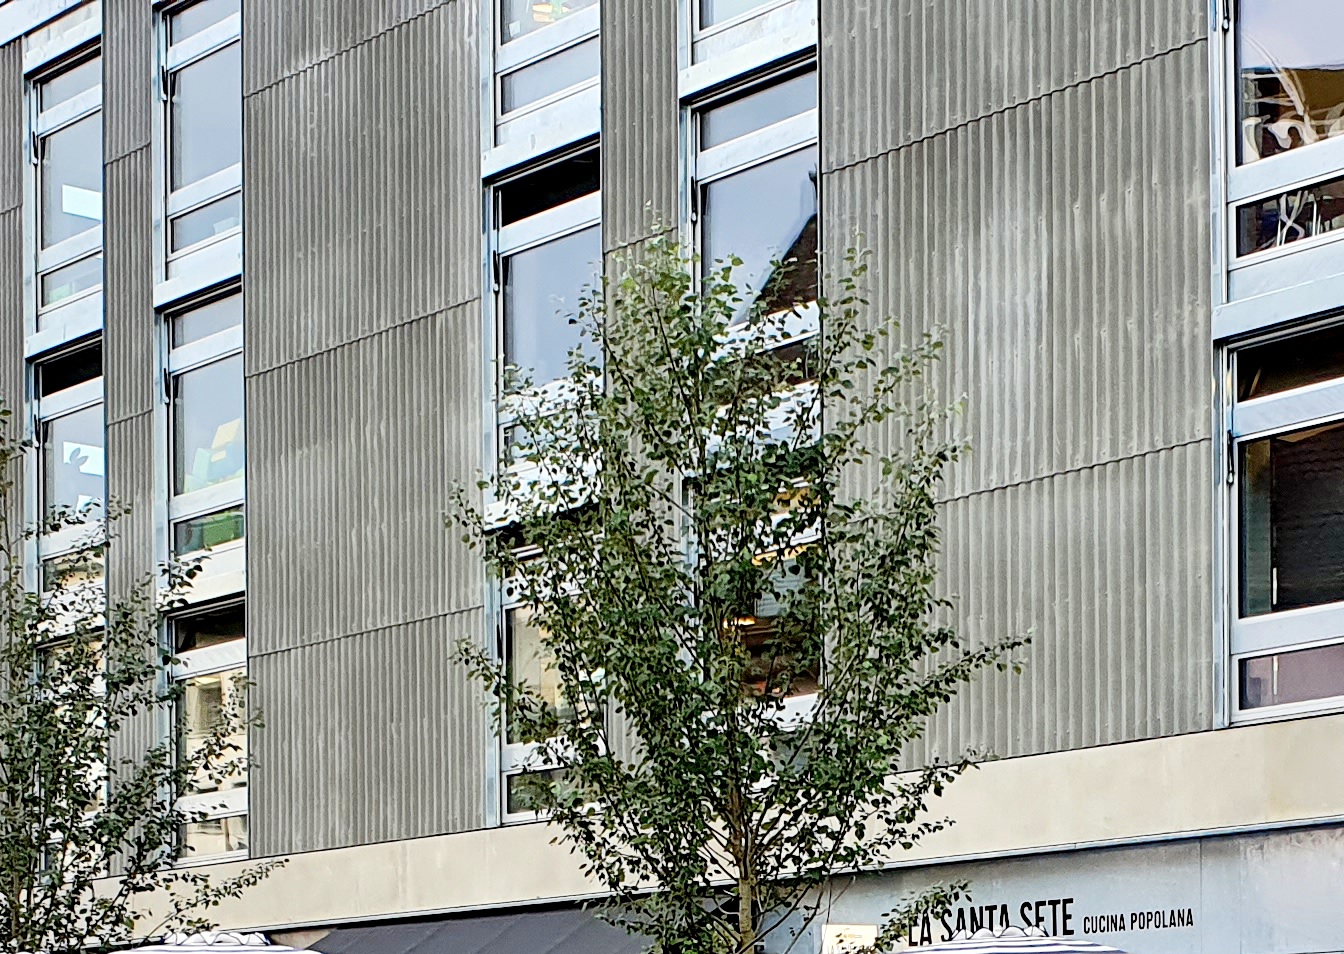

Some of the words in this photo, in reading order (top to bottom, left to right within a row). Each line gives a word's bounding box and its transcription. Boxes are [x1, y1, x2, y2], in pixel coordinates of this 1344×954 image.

[908, 908, 933, 947] LA
[941, 903, 1011, 942] SANTA
[1020, 898, 1075, 937] SETE
[1083, 914, 1126, 934] CUCINA
[1130, 908, 1195, 931] POPOLANA
